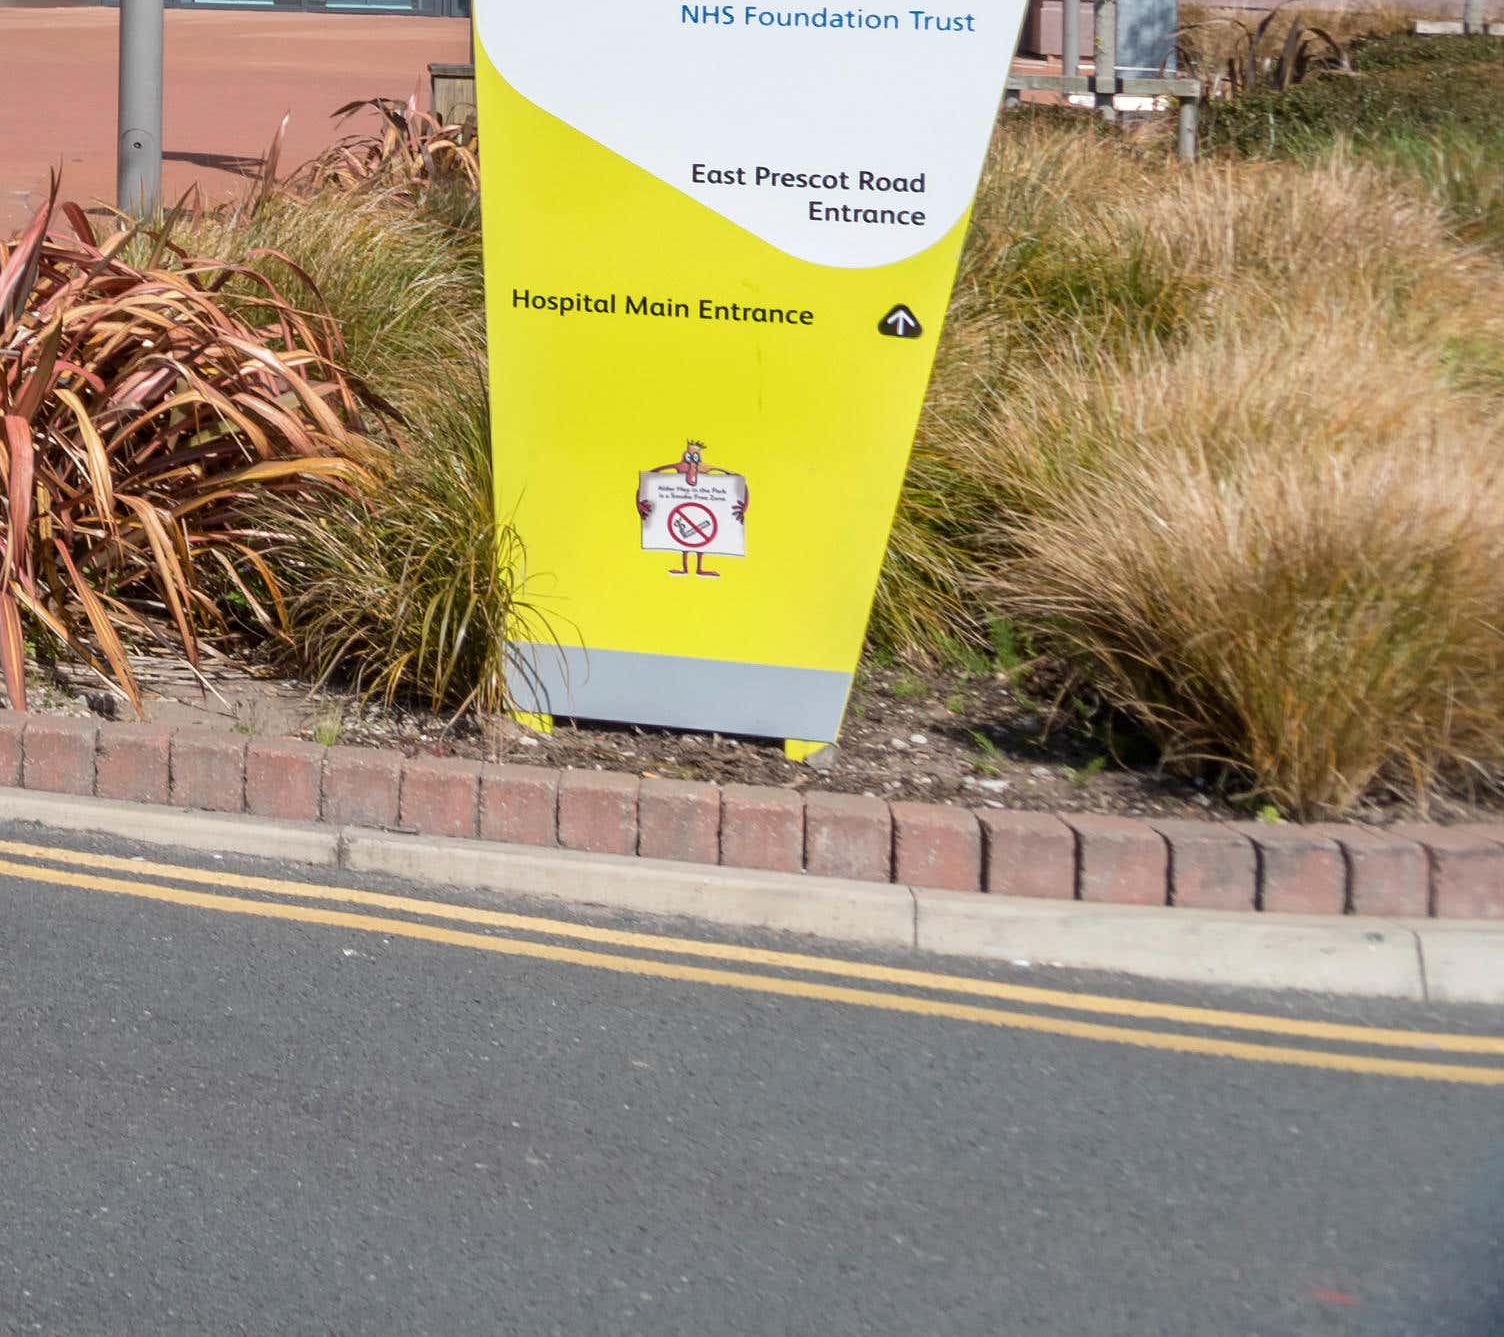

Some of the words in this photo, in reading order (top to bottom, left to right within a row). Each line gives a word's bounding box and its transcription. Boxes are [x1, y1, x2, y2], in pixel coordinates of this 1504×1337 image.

[681, 4, 734, 26] NHS
[744, 5, 900, 31] Foundation
[909, 10, 976, 33] Trust
[691, 163, 747, 186] East
[755, 166, 850, 190] Prescot
[859, 170, 926, 193] Road
[808, 200, 926, 227] Entrance
[512, 288, 616, 316] Hospital
[625, 294, 689, 319] Main
[699, 299, 814, 326] Entrance
